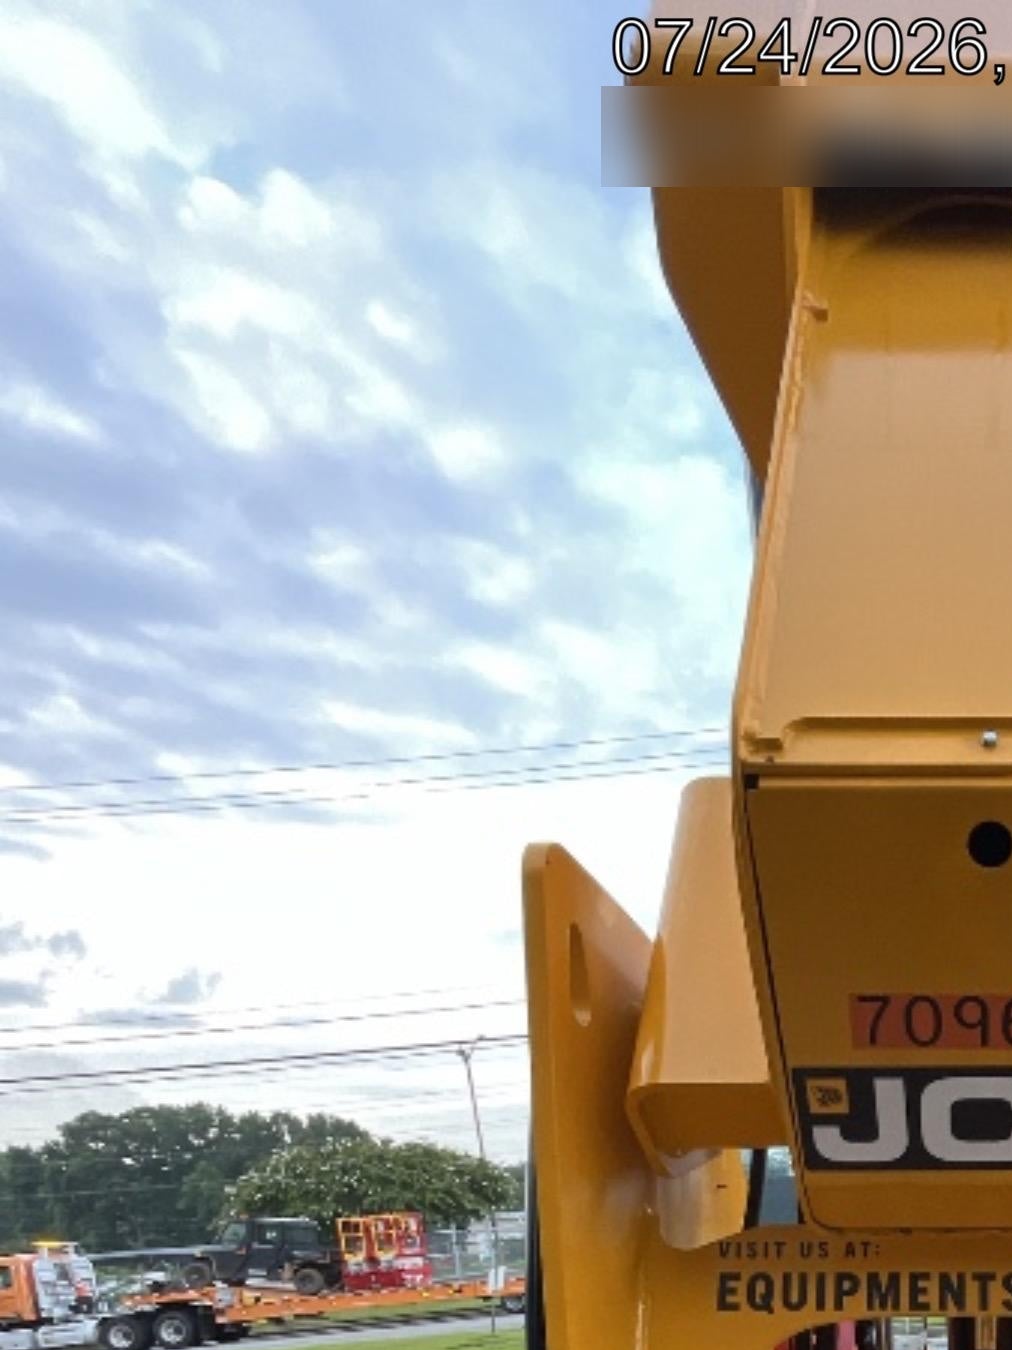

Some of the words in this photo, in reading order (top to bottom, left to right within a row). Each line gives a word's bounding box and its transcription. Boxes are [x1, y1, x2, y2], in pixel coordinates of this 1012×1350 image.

[718, 1241, 787, 1260] VISIT
[800, 1241, 829, 1259] US
[844, 1241, 880, 1259] AT:
